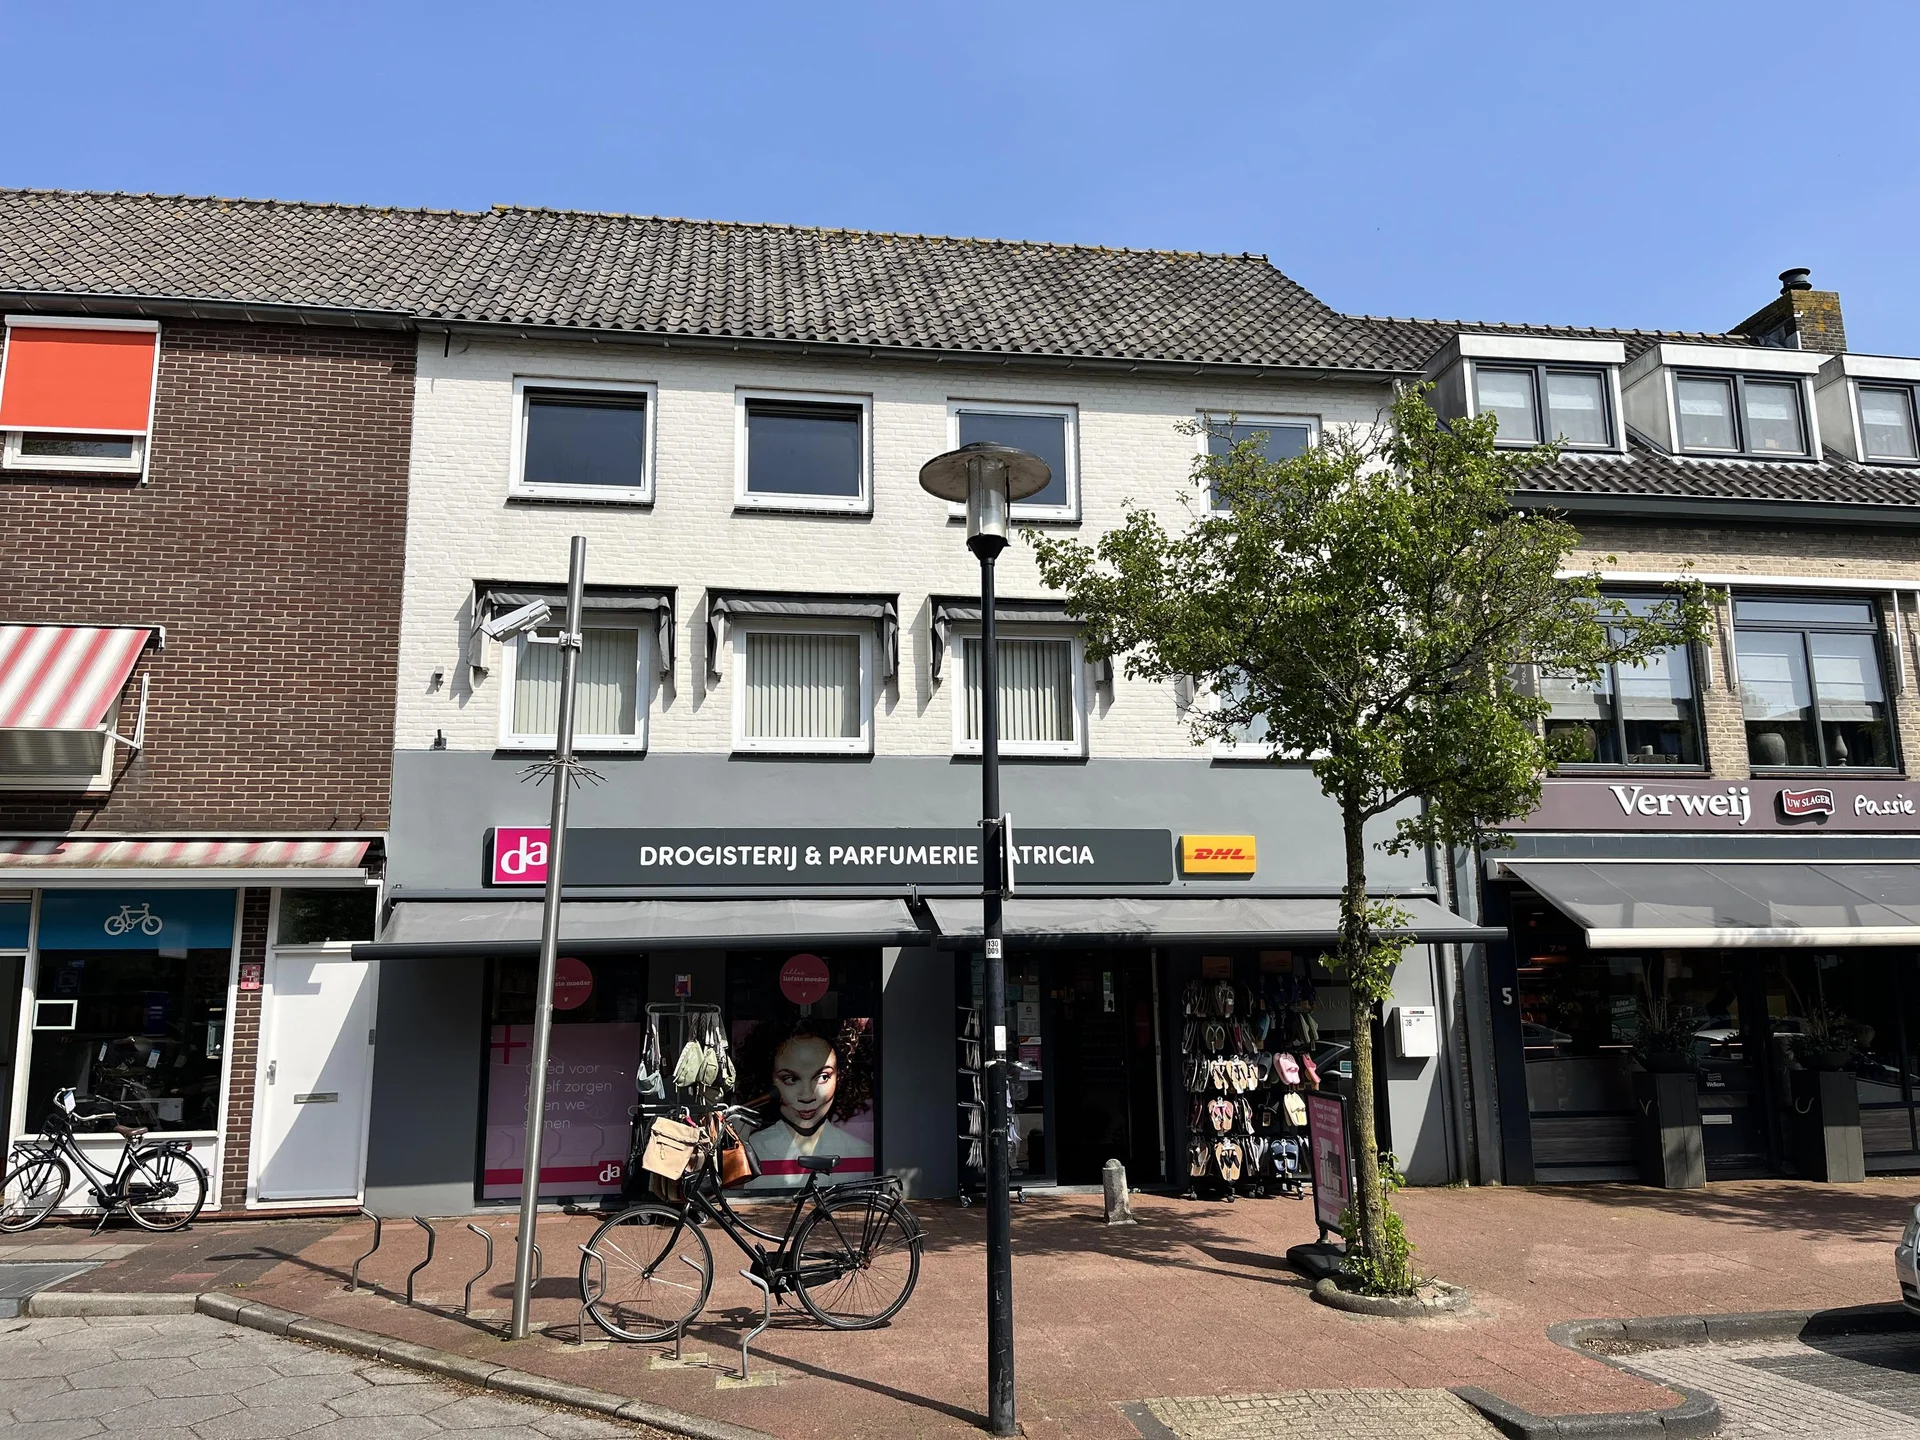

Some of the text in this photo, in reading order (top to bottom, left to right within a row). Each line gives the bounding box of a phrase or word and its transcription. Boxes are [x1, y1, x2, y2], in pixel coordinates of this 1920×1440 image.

[1609, 785, 1752, 826] Verweij
[1786, 794, 1831, 808] UW SLAGER
[1853, 793, 1916, 816] Passie
[500, 836, 548, 875] da
[640, 845, 1095, 871] DROGISTERIJ & PARFUMERIE ATRICIA
[1193, 848, 1246, 860] DHL
[987, 940, 999, 948] 130
[1501, 987, 1513, 1006] 5
[569, 1064, 600, 1075] voor
[564, 1082, 612, 1096] zorgen
[564, 1101, 586, 1111] we
[599, 1163, 621, 1182] da
